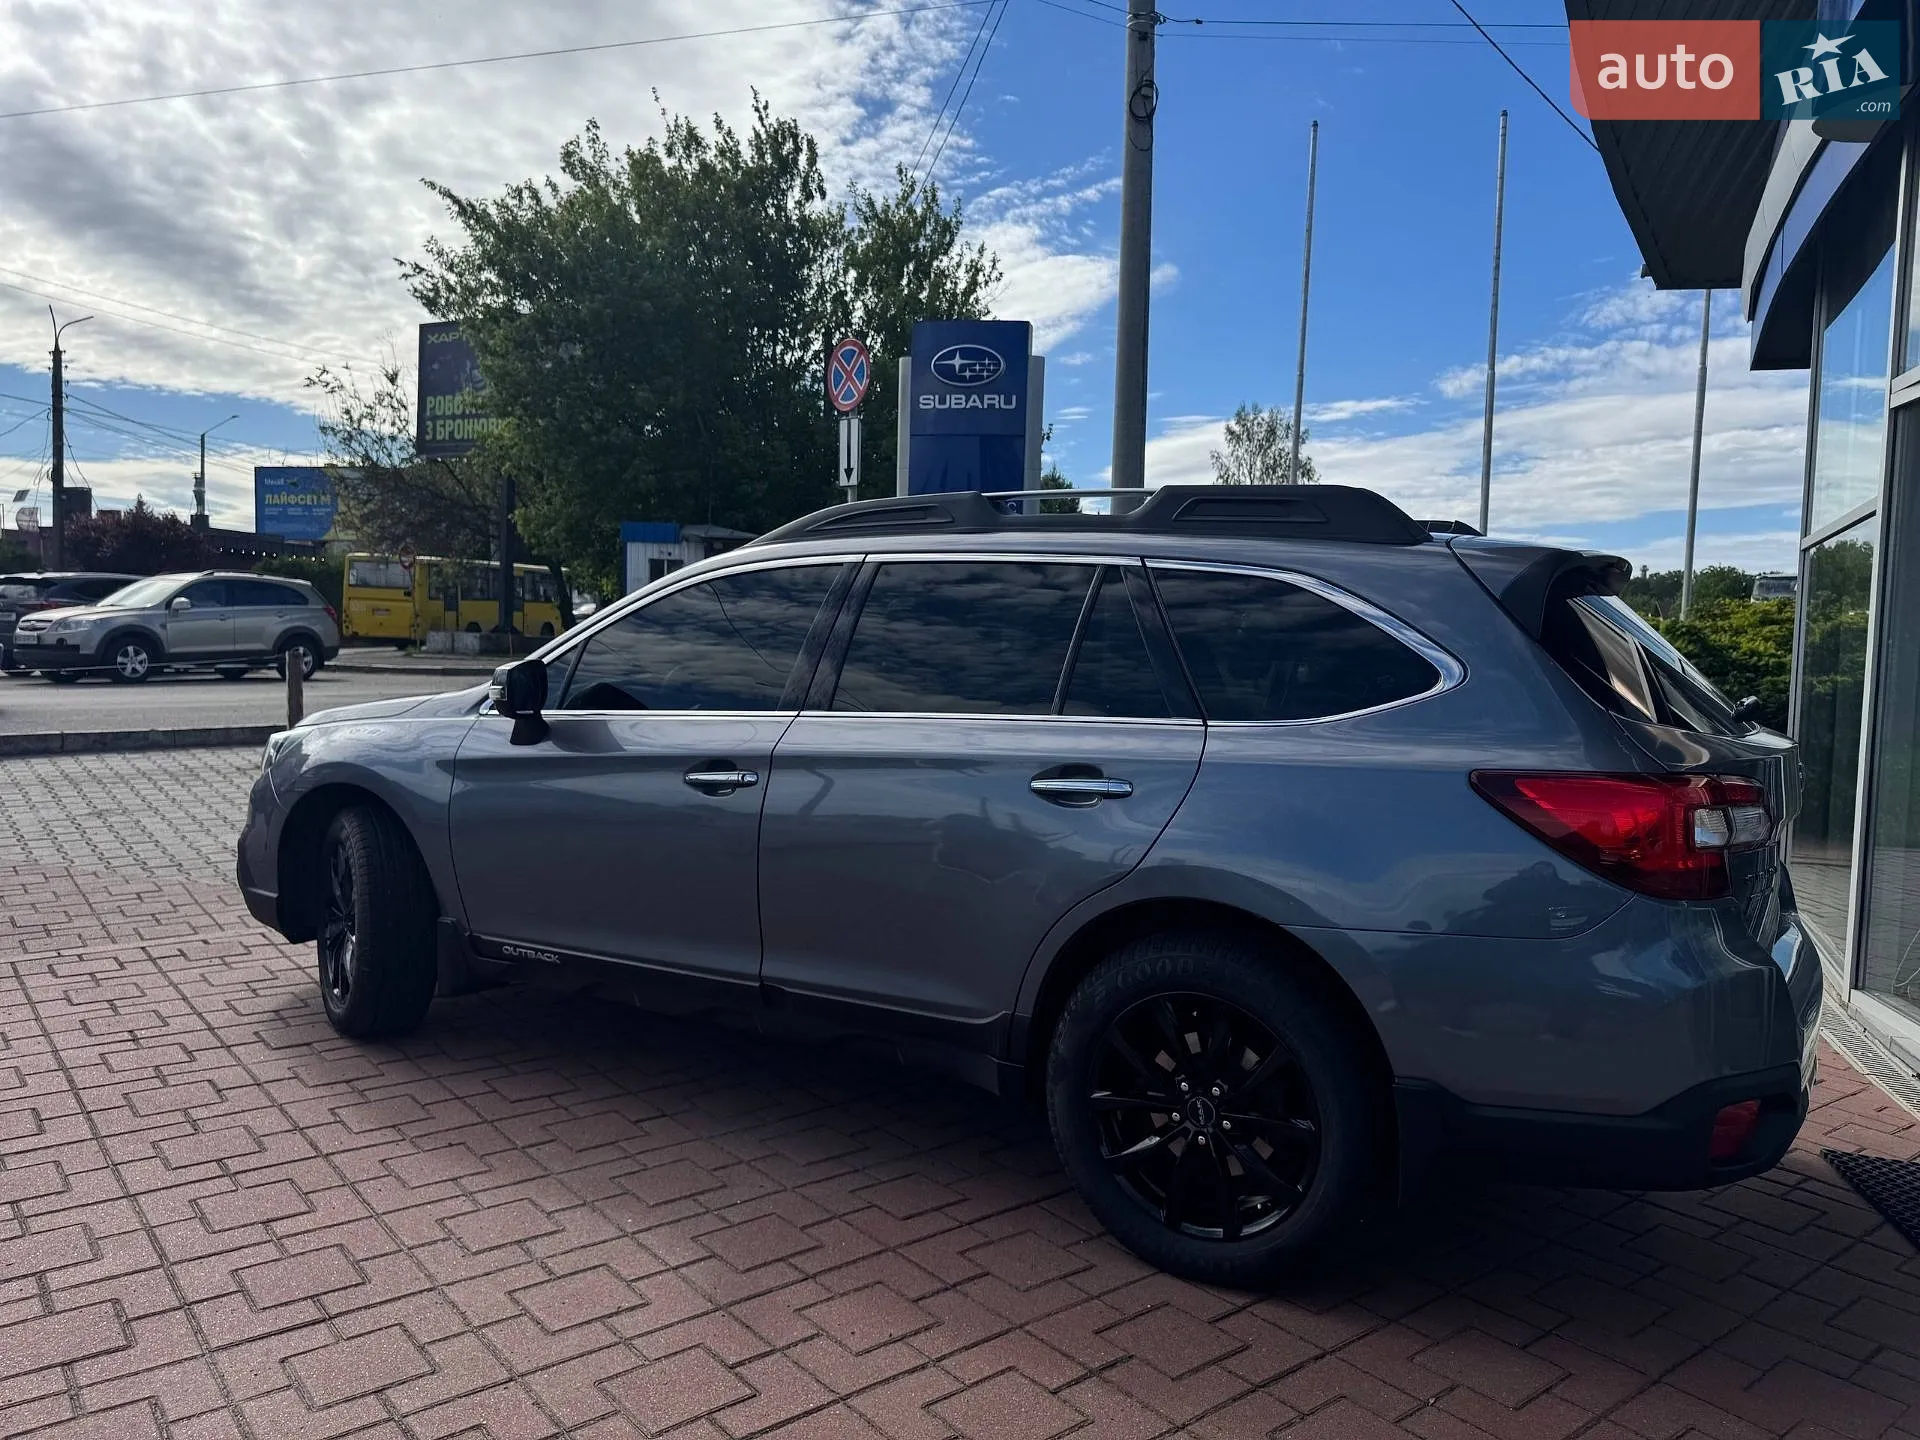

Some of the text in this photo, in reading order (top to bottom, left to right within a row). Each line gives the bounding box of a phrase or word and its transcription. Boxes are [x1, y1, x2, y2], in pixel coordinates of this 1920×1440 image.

[919, 394, 1017, 410] SUBARU
[436, 418, 504, 440] БРОНЮВ
[265, 491, 318, 505] ЛАЙФСЕТ
[502, 945, 561, 964] OUTBACK
